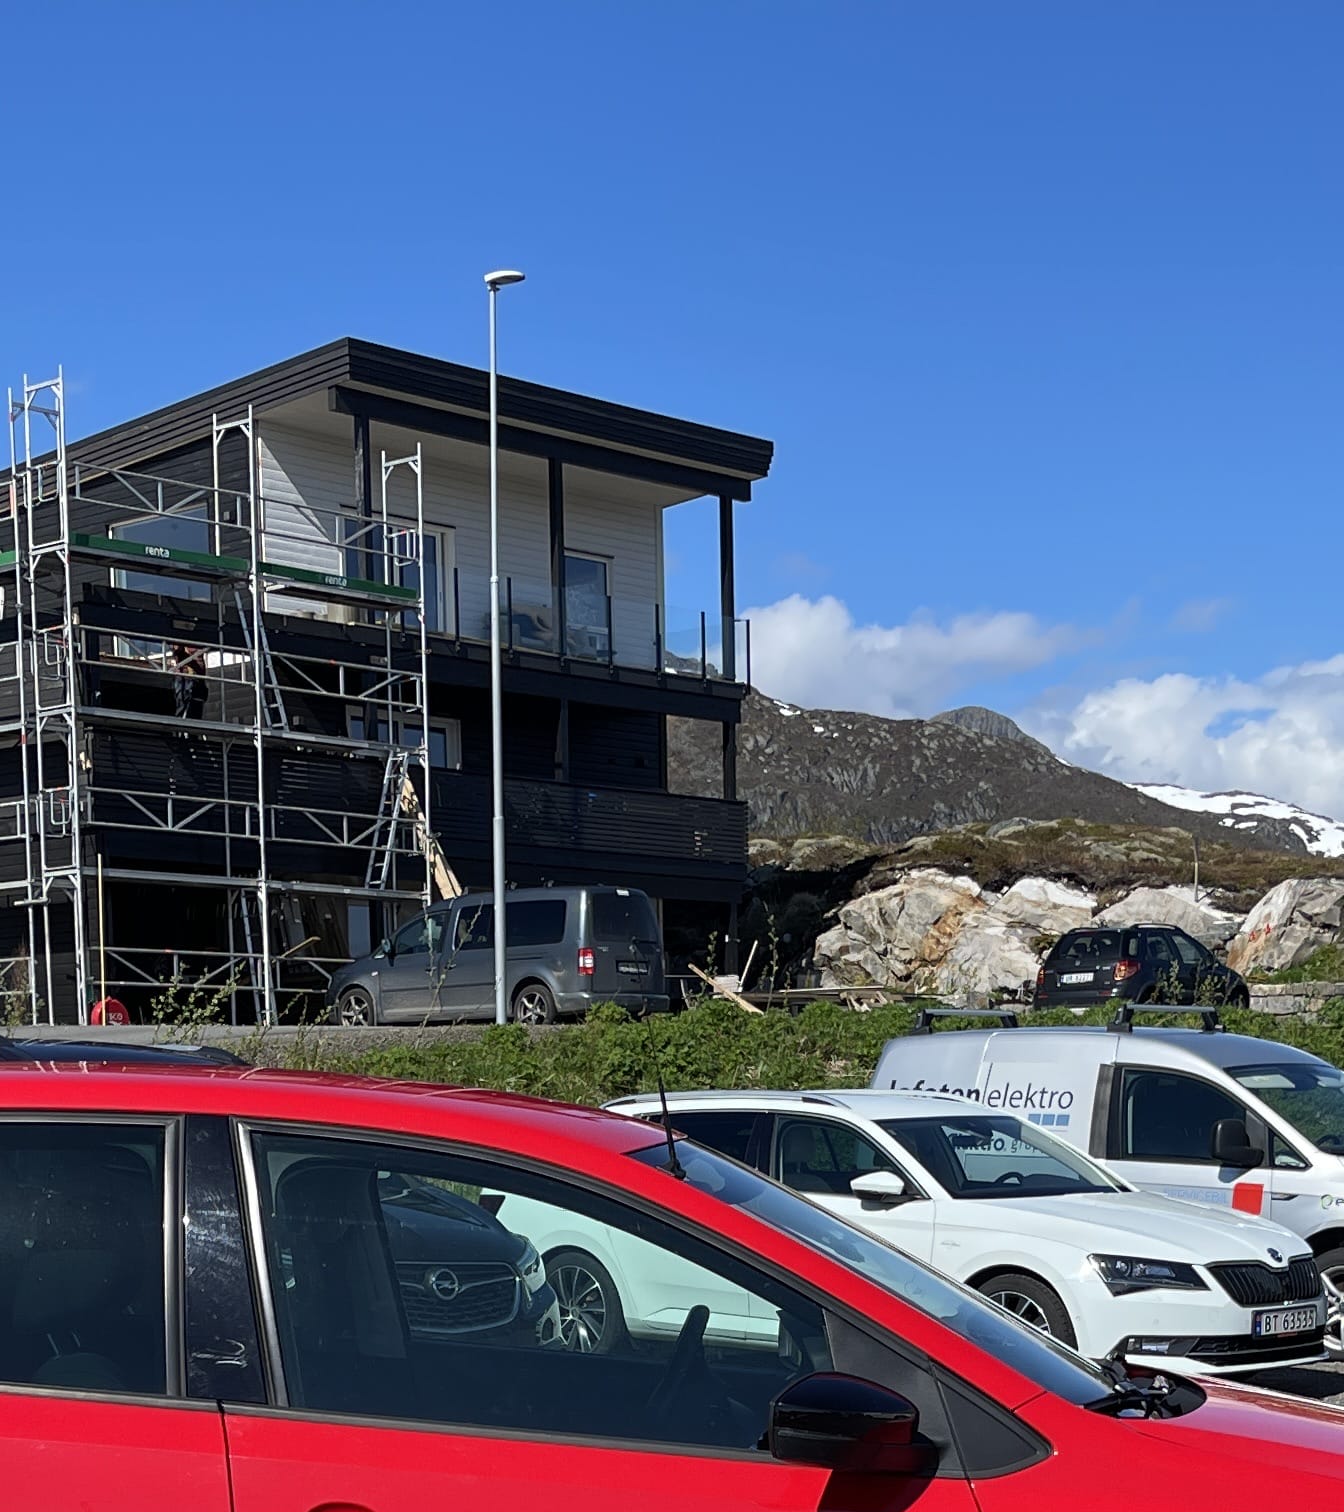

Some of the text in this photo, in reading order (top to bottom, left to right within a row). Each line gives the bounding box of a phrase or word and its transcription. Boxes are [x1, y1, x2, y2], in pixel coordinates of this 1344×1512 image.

[145, 546, 170, 558] renta
[987, 1082, 1074, 1109] elektro
[1264, 1310, 1314, 1333] BT 63535
